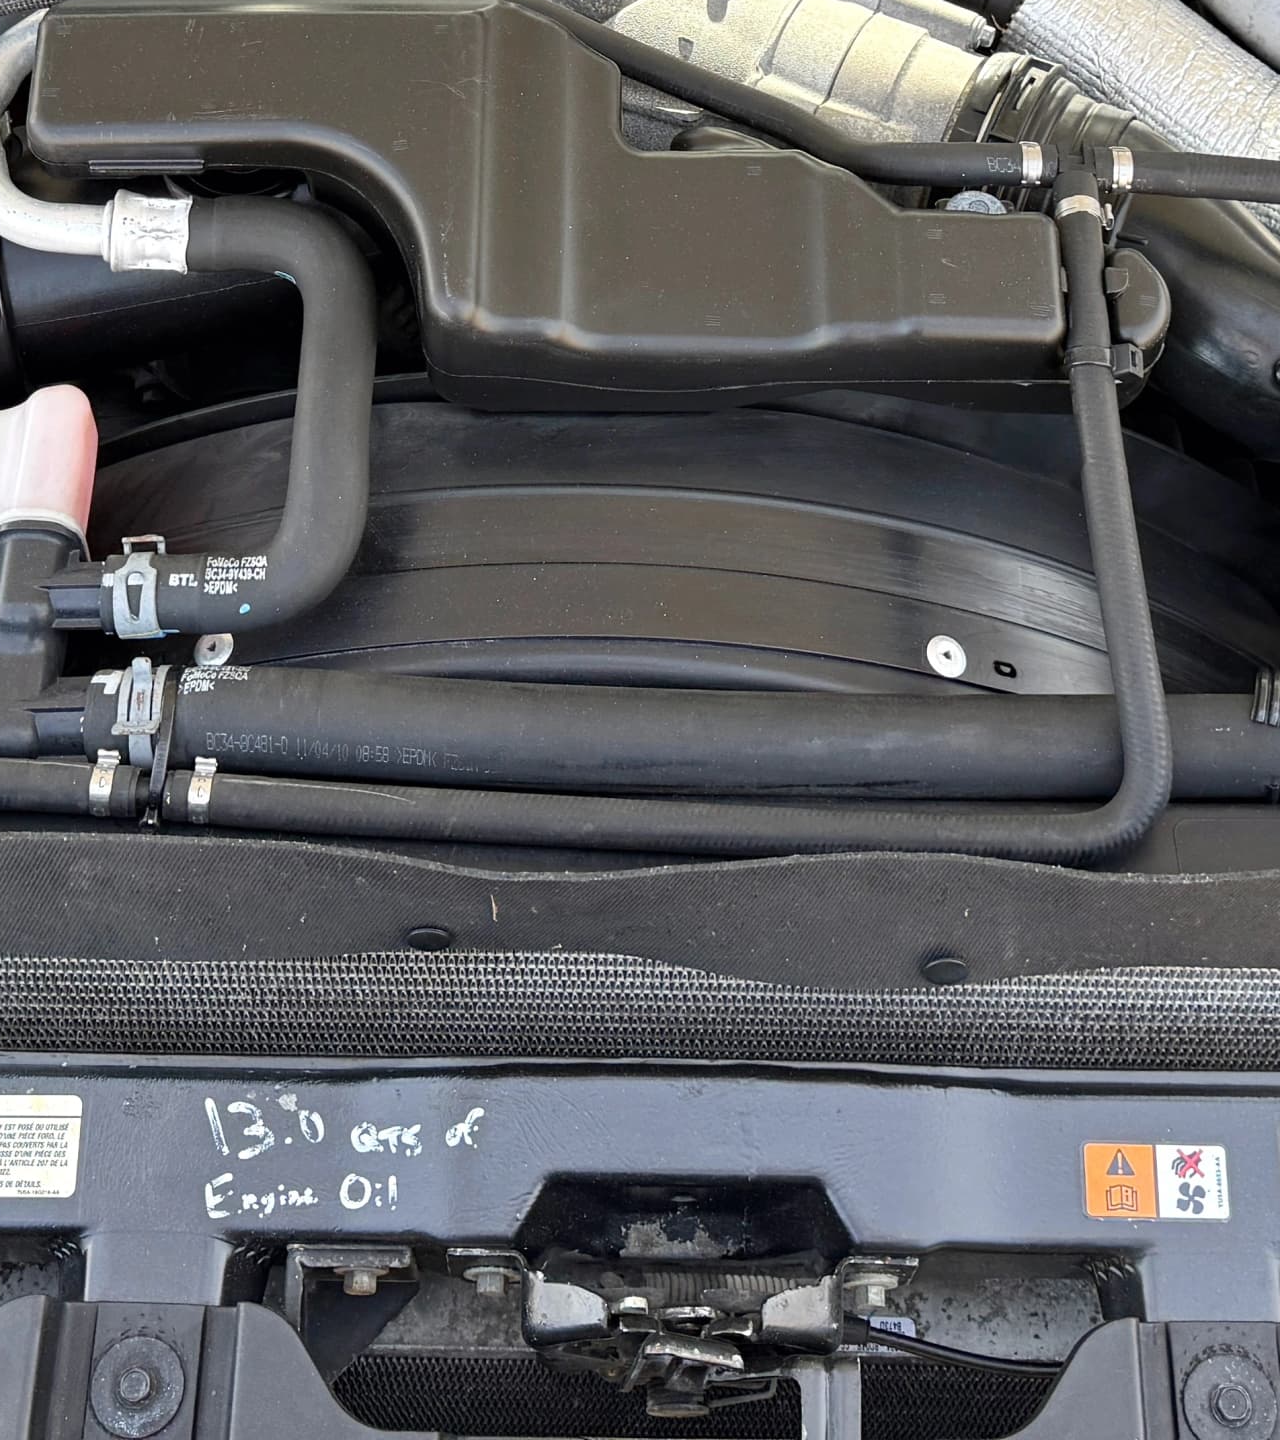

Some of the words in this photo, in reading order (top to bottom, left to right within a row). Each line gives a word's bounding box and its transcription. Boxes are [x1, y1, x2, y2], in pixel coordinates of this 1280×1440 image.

[168, 573, 198, 587] BTL
[204, 1097, 325, 1160] 13.0
[204, 1172, 319, 1220] Engine
[339, 1172, 399, 1211] Oil
